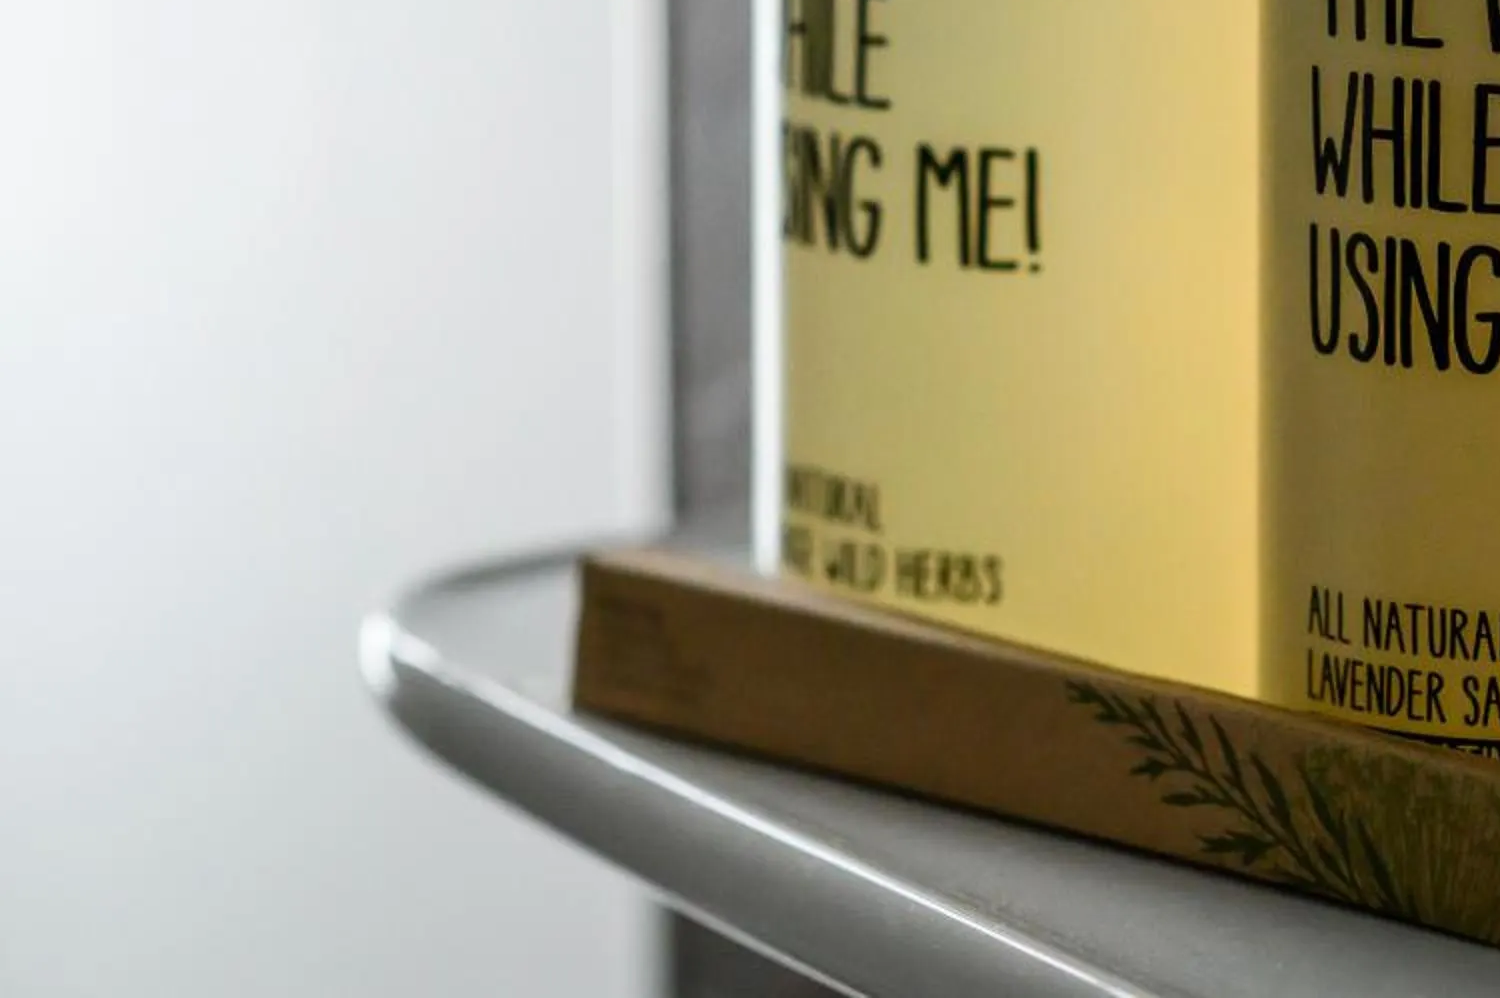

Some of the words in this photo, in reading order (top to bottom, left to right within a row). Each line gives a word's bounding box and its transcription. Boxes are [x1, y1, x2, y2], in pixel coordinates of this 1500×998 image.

[915, 141, 1041, 273] ME!
[895, 549, 1004, 607] HERBS
[1307, 584, 1351, 646] ALL
[1306, 648, 1447, 724] LAVENDER
